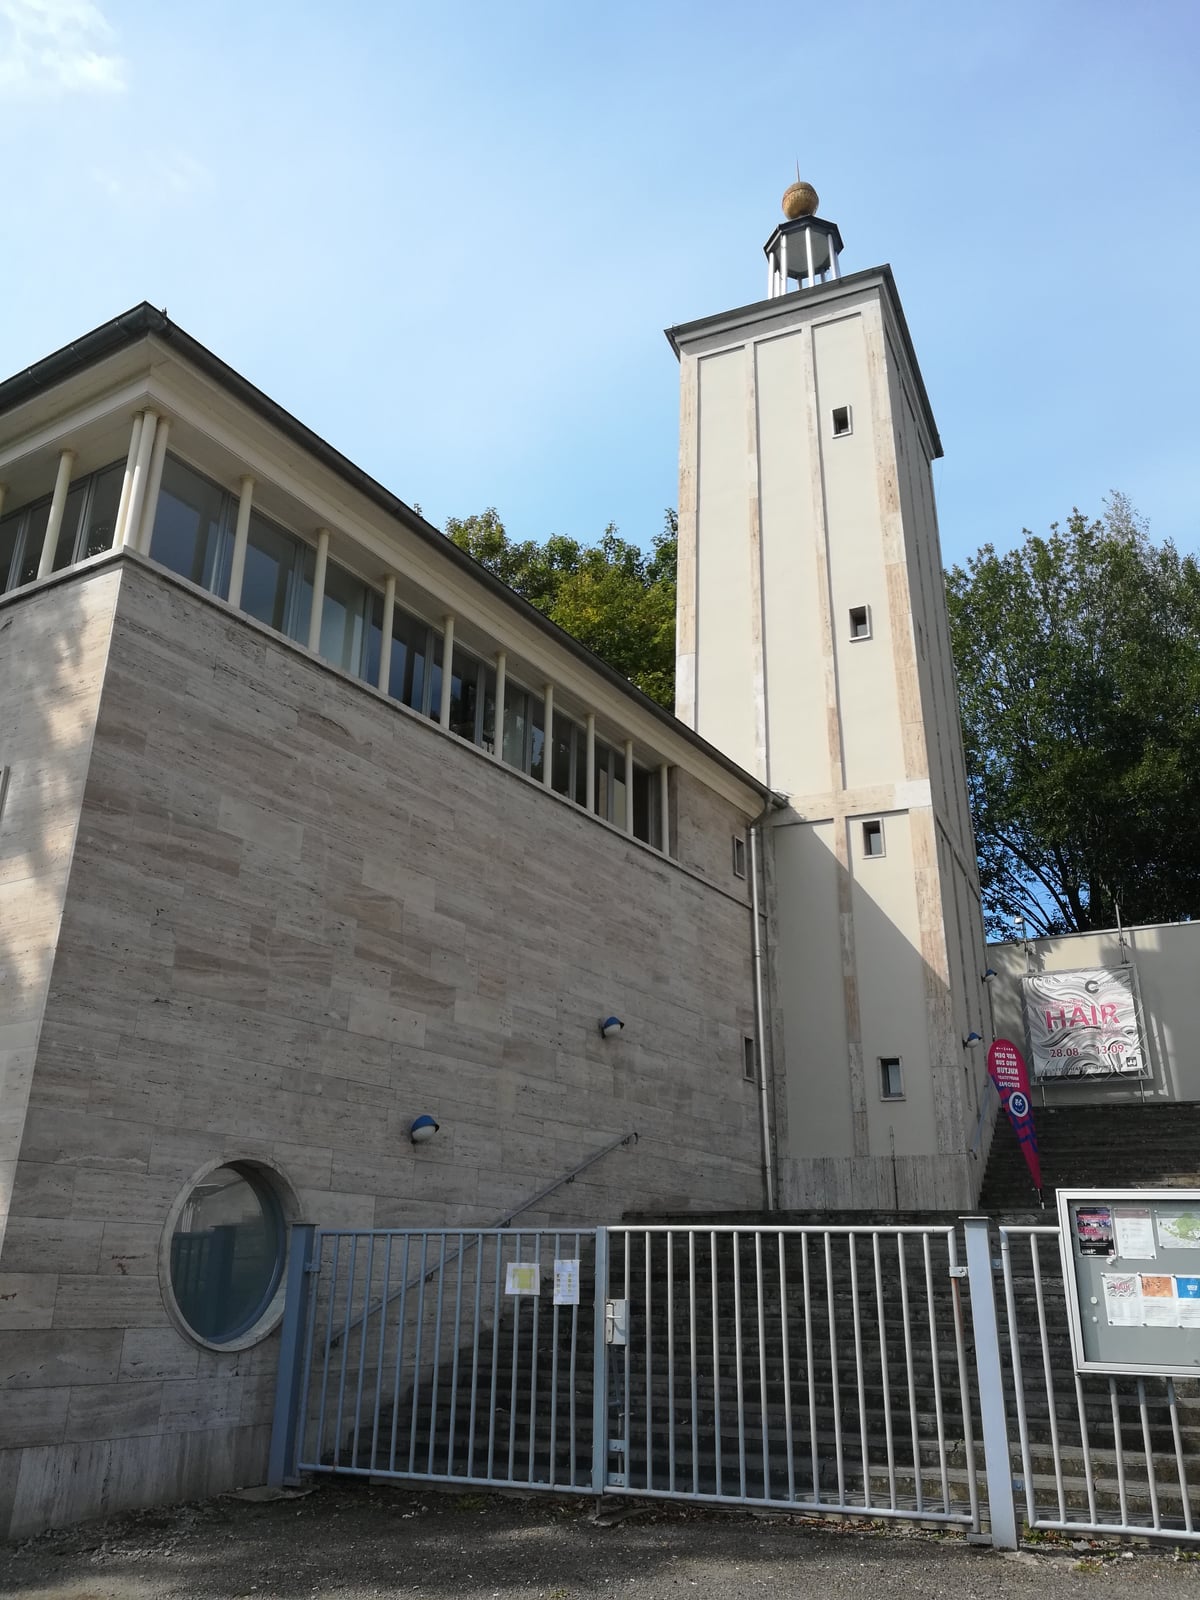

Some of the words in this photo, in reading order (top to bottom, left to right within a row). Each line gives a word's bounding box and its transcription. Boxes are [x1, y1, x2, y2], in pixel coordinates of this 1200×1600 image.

[1046, 1003, 1120, 1029] HAIR
[1049, 1048, 1082, 1058] 28.08.
[1095, 1044, 1128, 1055] 13.09.
